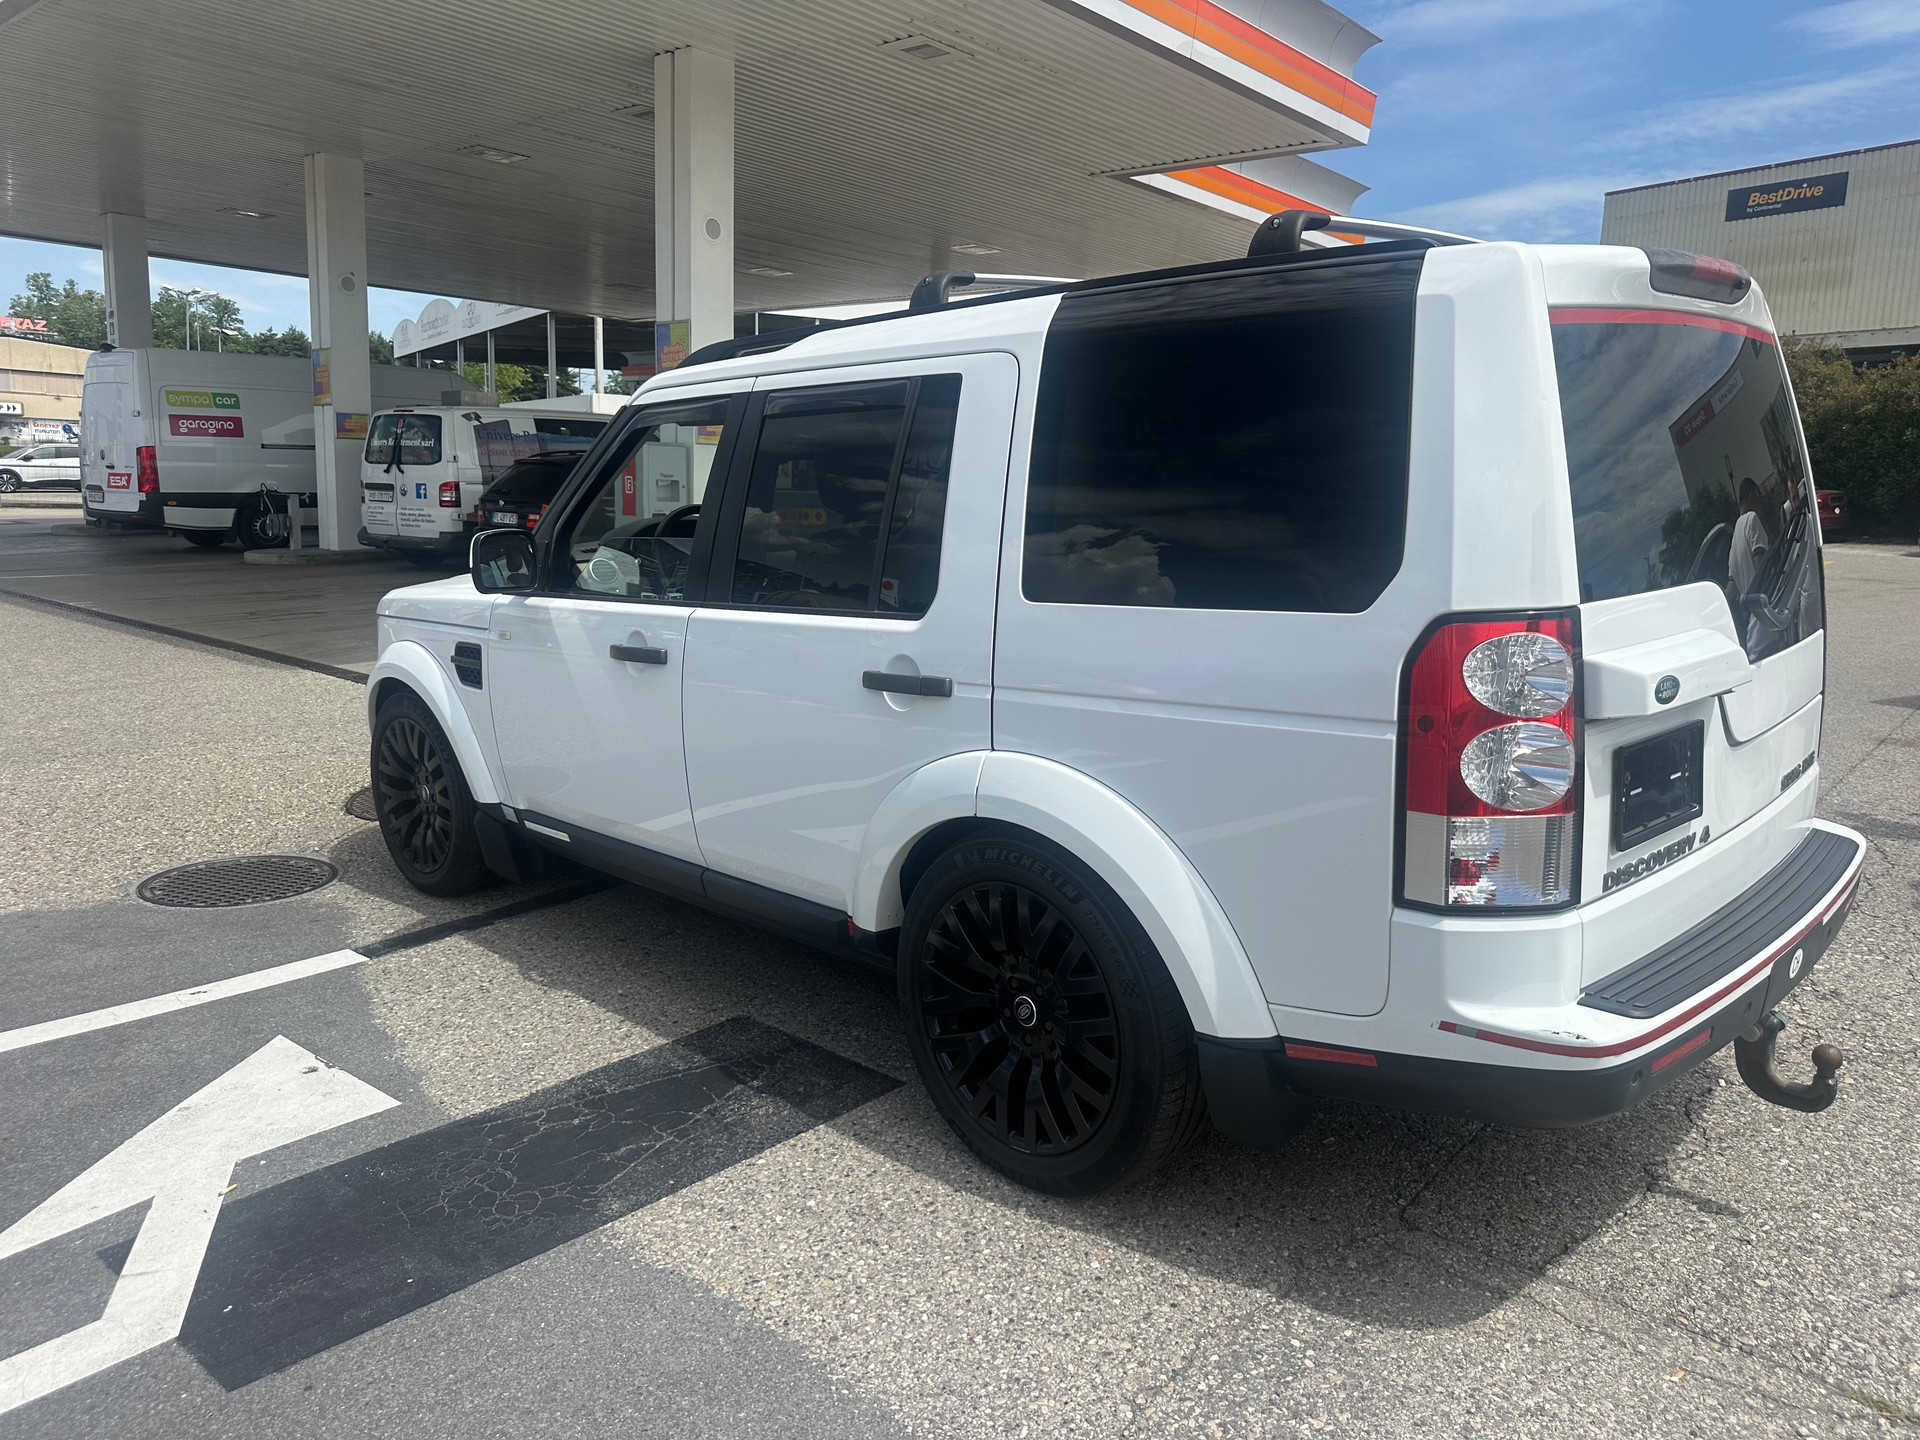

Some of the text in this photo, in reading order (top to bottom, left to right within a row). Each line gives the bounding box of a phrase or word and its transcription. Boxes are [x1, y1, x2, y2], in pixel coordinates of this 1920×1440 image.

[1748, 183, 1824, 206] BestDrive
[1754, 203, 1782, 212] Continental
[215, 397, 237, 405] car
[179, 420, 234, 434] garagino
[1602, 825, 1711, 893] DISCOVERY 4
[984, 847, 1079, 899] MICHELIN
